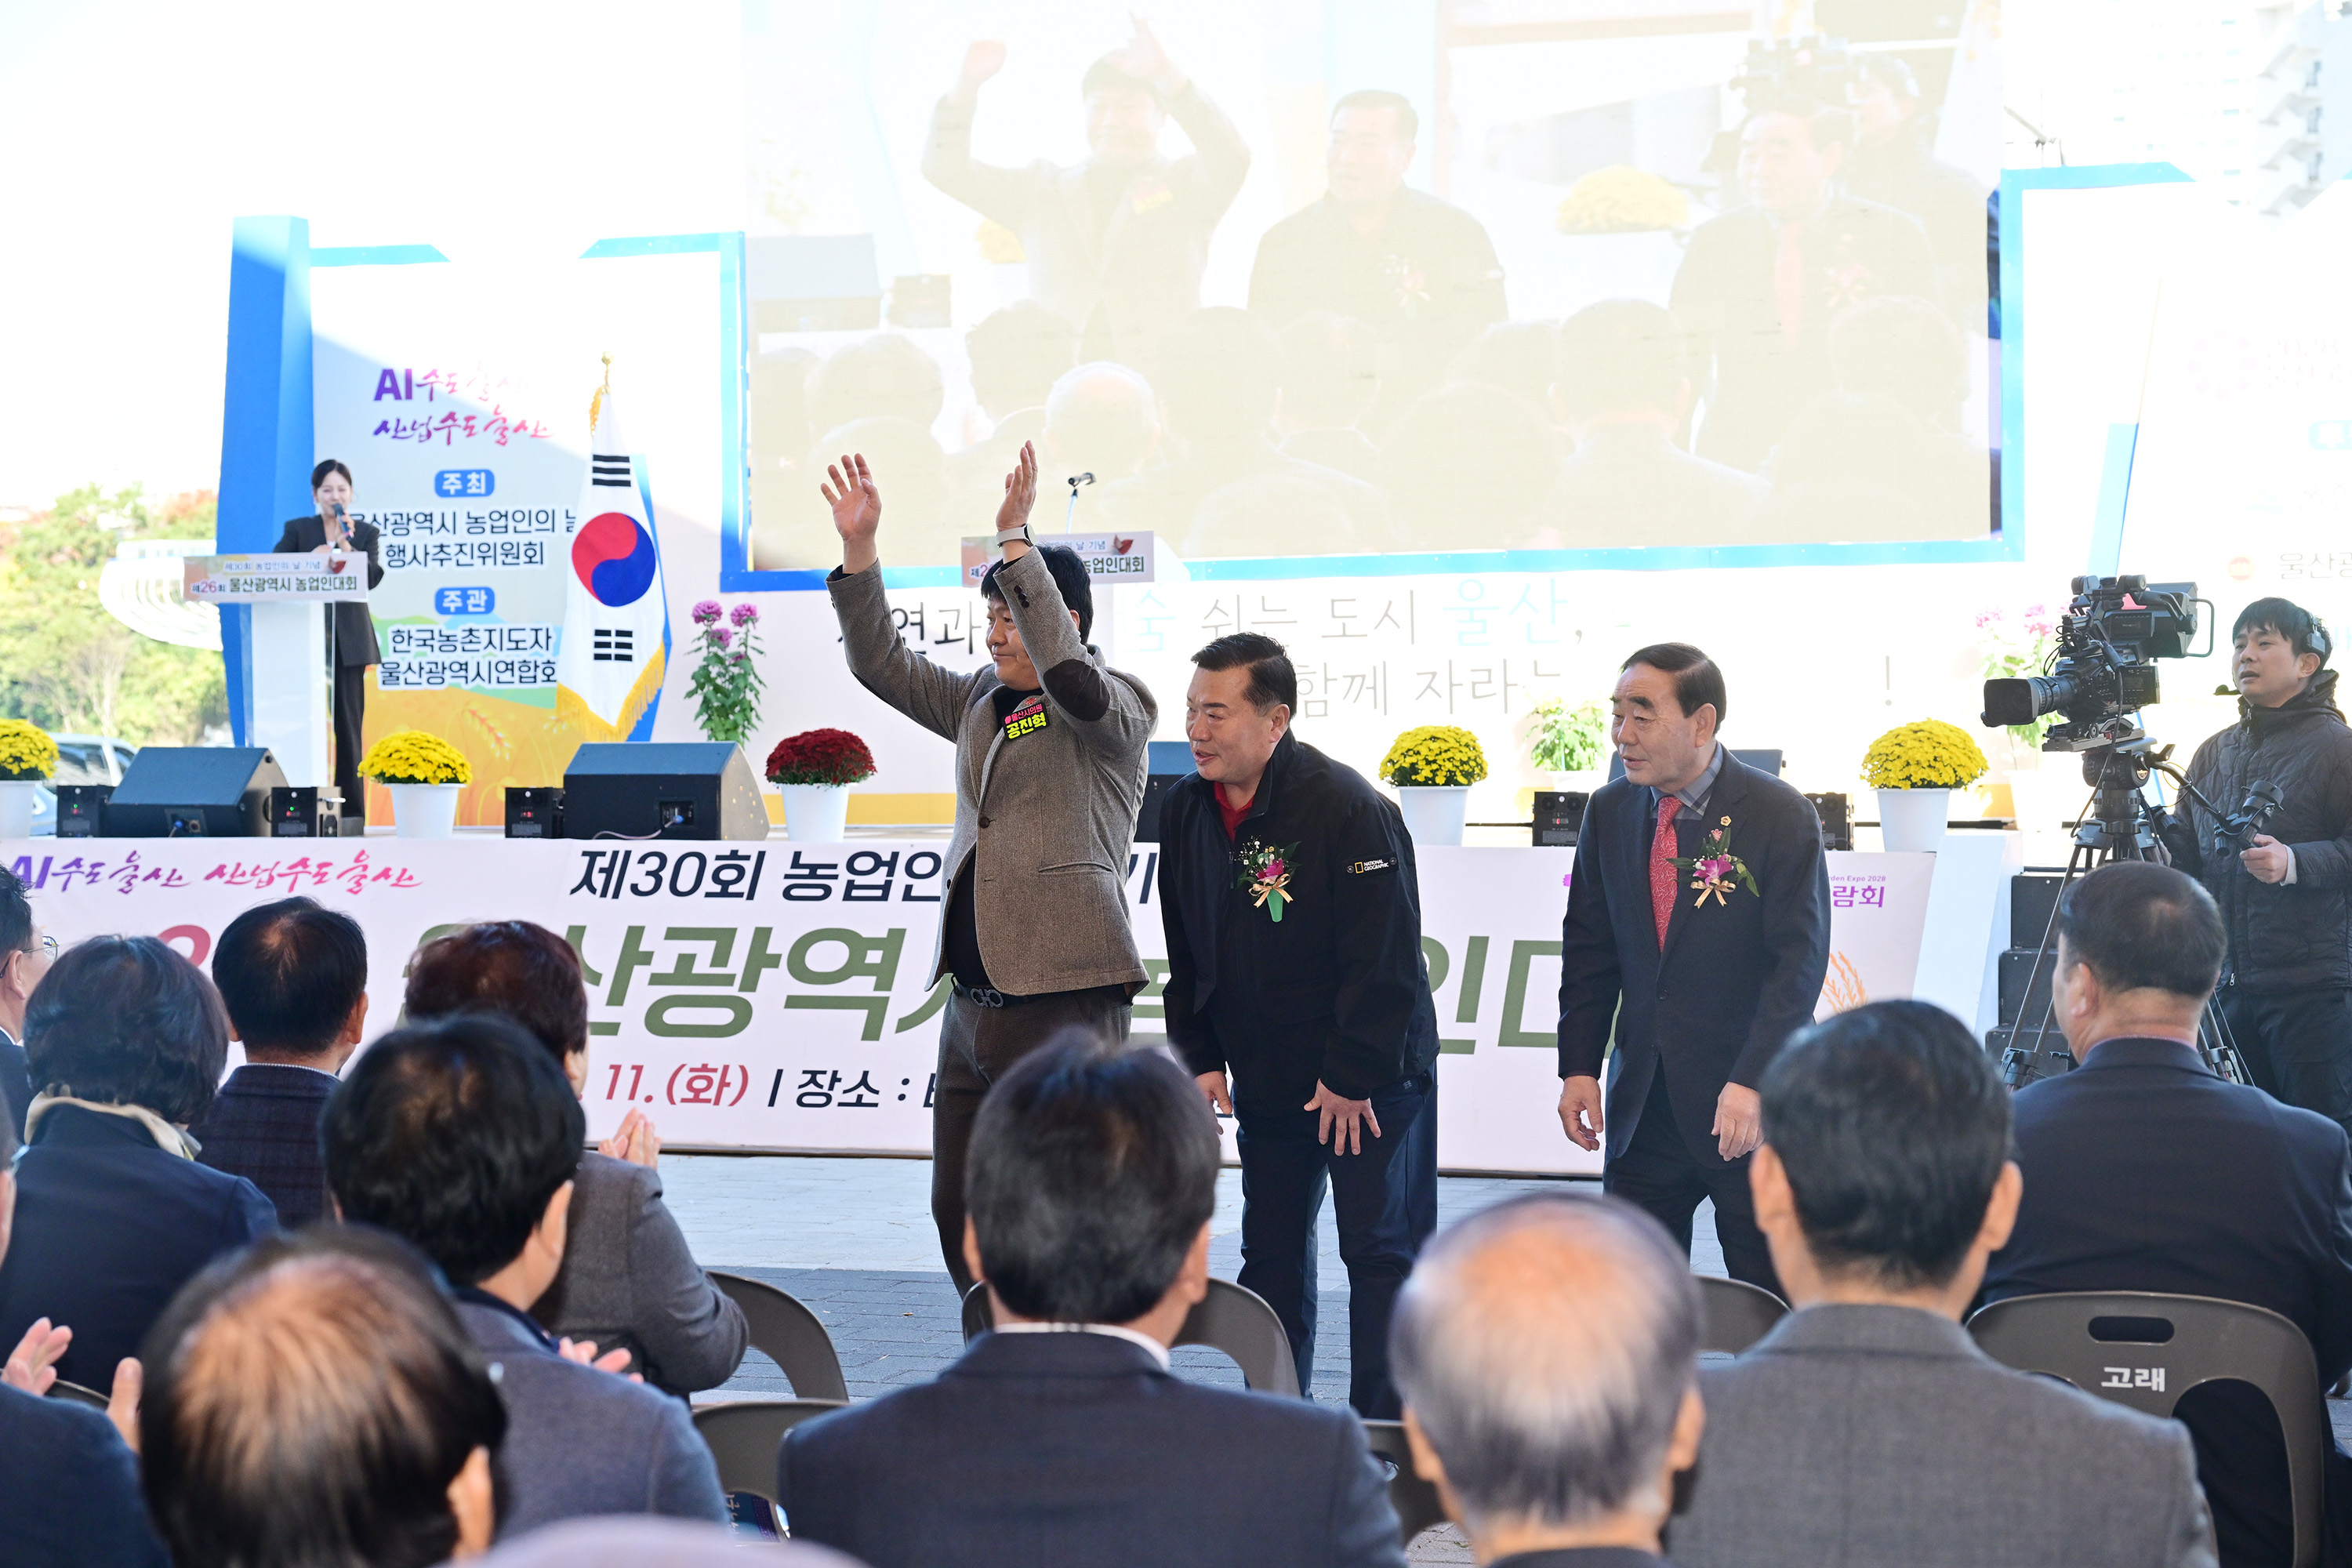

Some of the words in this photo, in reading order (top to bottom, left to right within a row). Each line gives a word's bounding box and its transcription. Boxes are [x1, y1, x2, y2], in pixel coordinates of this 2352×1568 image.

[442, 472, 486, 495] 주최
[466, 509, 555, 535] 농업인의
[386, 541, 544, 568] 행사추진위원회
[1076, 541, 1086, 550] 날
[1089, 539, 1106, 550] 기념
[305, 560, 321, 571] 기념
[229, 575, 291, 593] 울산광역시
[296, 575, 358, 591] 농업인대회
[442, 590, 487, 612] 주관
[1321, 590, 1414, 645] 도시
[392, 626, 552, 653] 한국농촌지도자
[1297, 660, 1388, 719] 함께
[1006, 712, 1047, 739] 공진혁
[570, 849, 766, 901] 제30회
[1363, 858, 1384, 867] NATIONAL
[1364, 862, 1389, 872] GEOGRAPHIC
[796, 1069, 880, 1109] 장소
[2100, 1366, 2165, 1392] 고래
